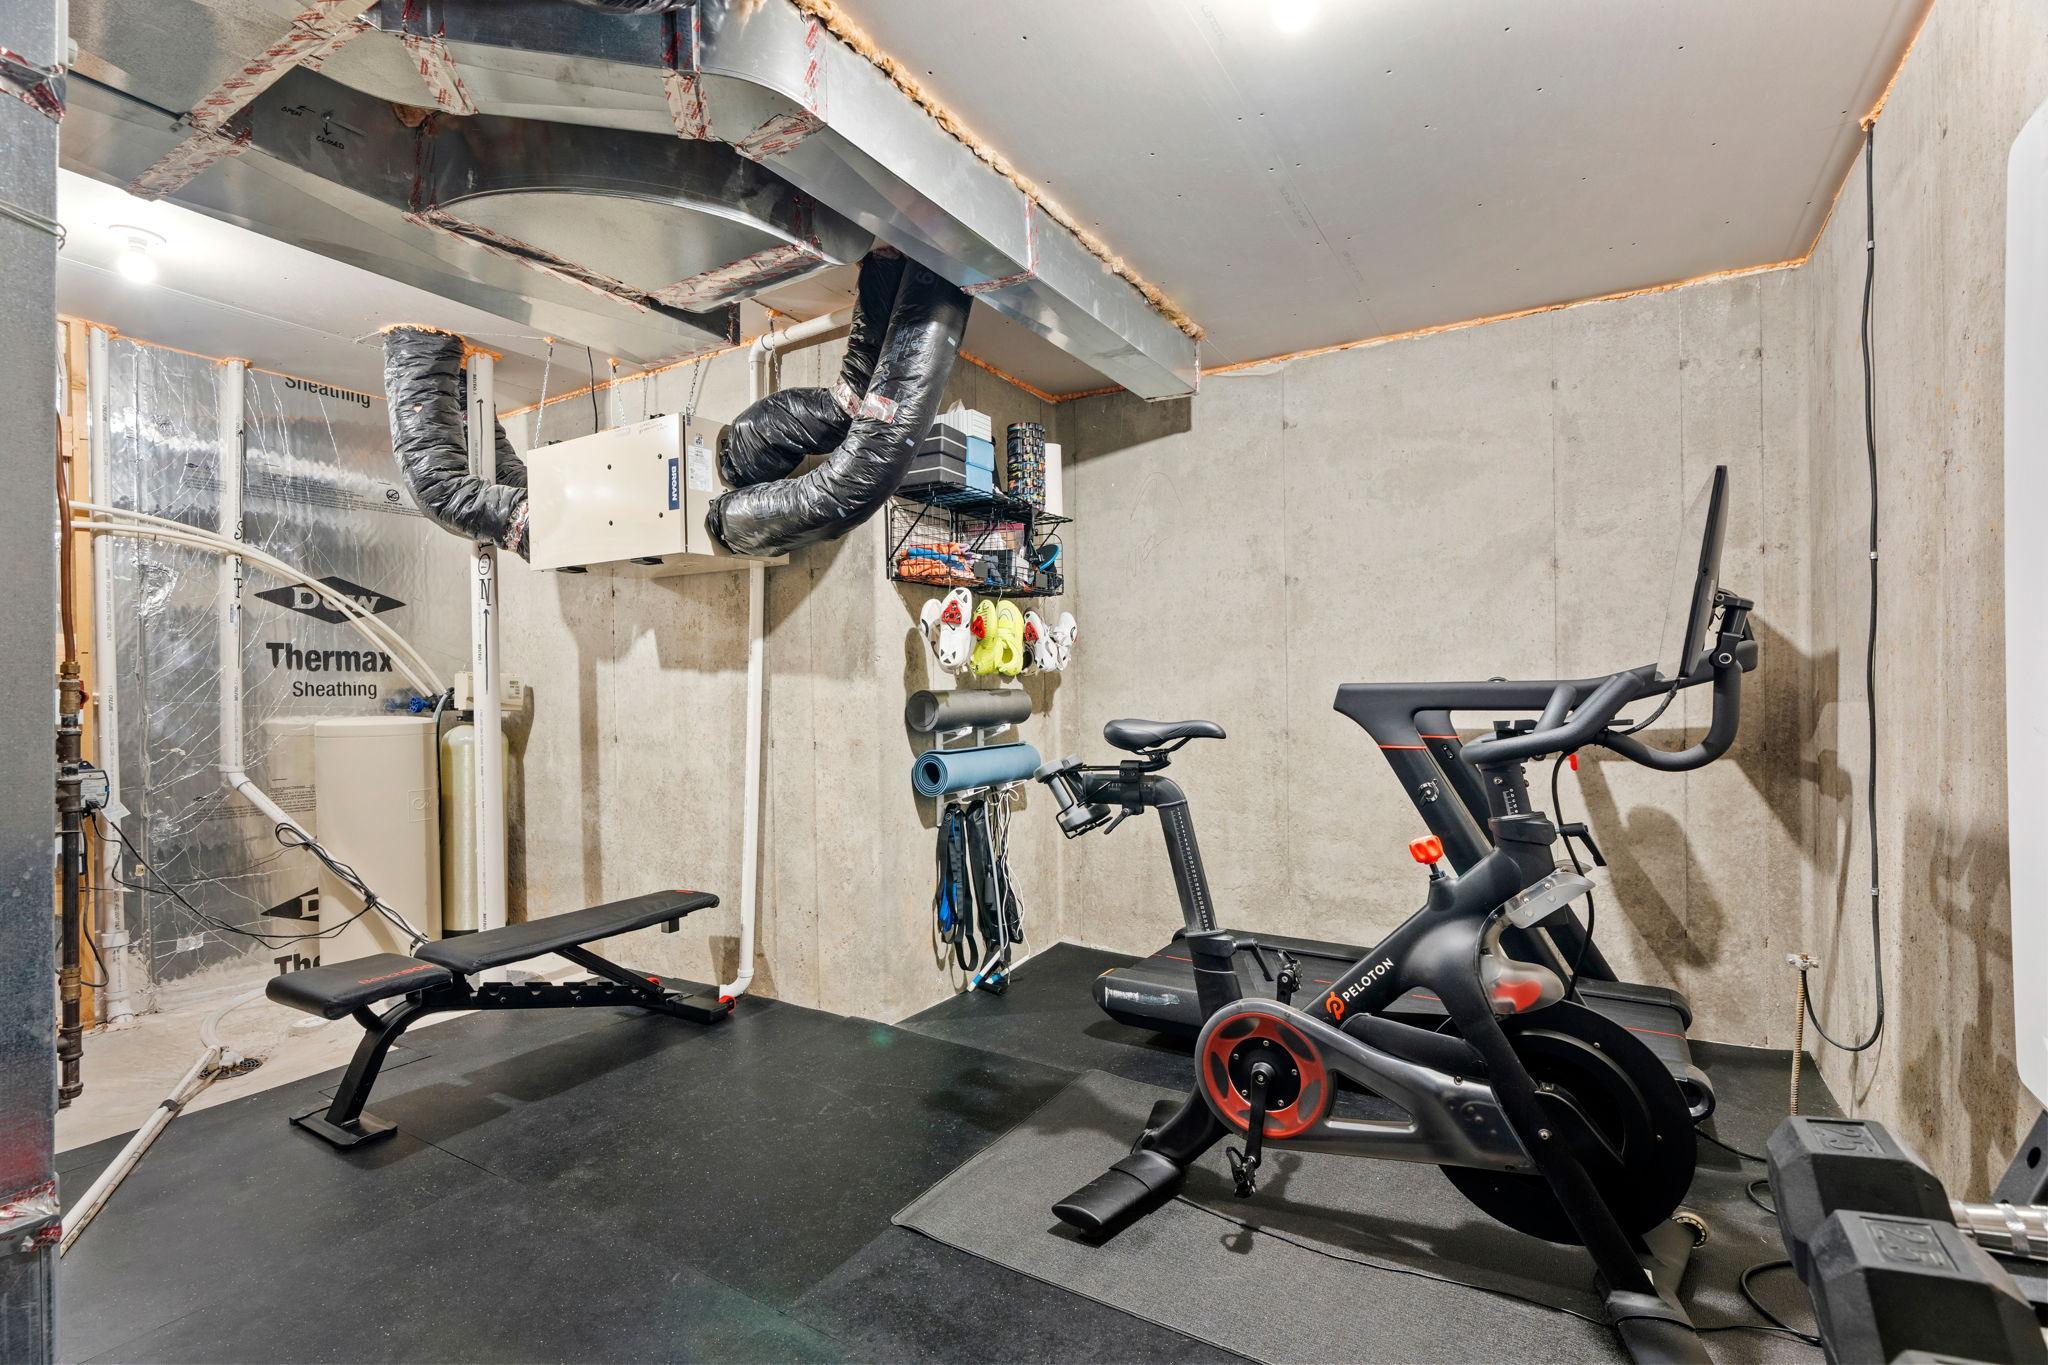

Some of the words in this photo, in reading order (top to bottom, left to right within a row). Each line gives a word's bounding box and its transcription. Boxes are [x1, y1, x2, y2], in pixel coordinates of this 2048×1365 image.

[280, 106, 302, 117] OPEN
[316, 135, 345, 150] CLOSED
[265, 642, 393, 673] Thermax
[292, 681, 377, 700] Sheathing
[1341, 957, 1394, 1002] PELOTON
